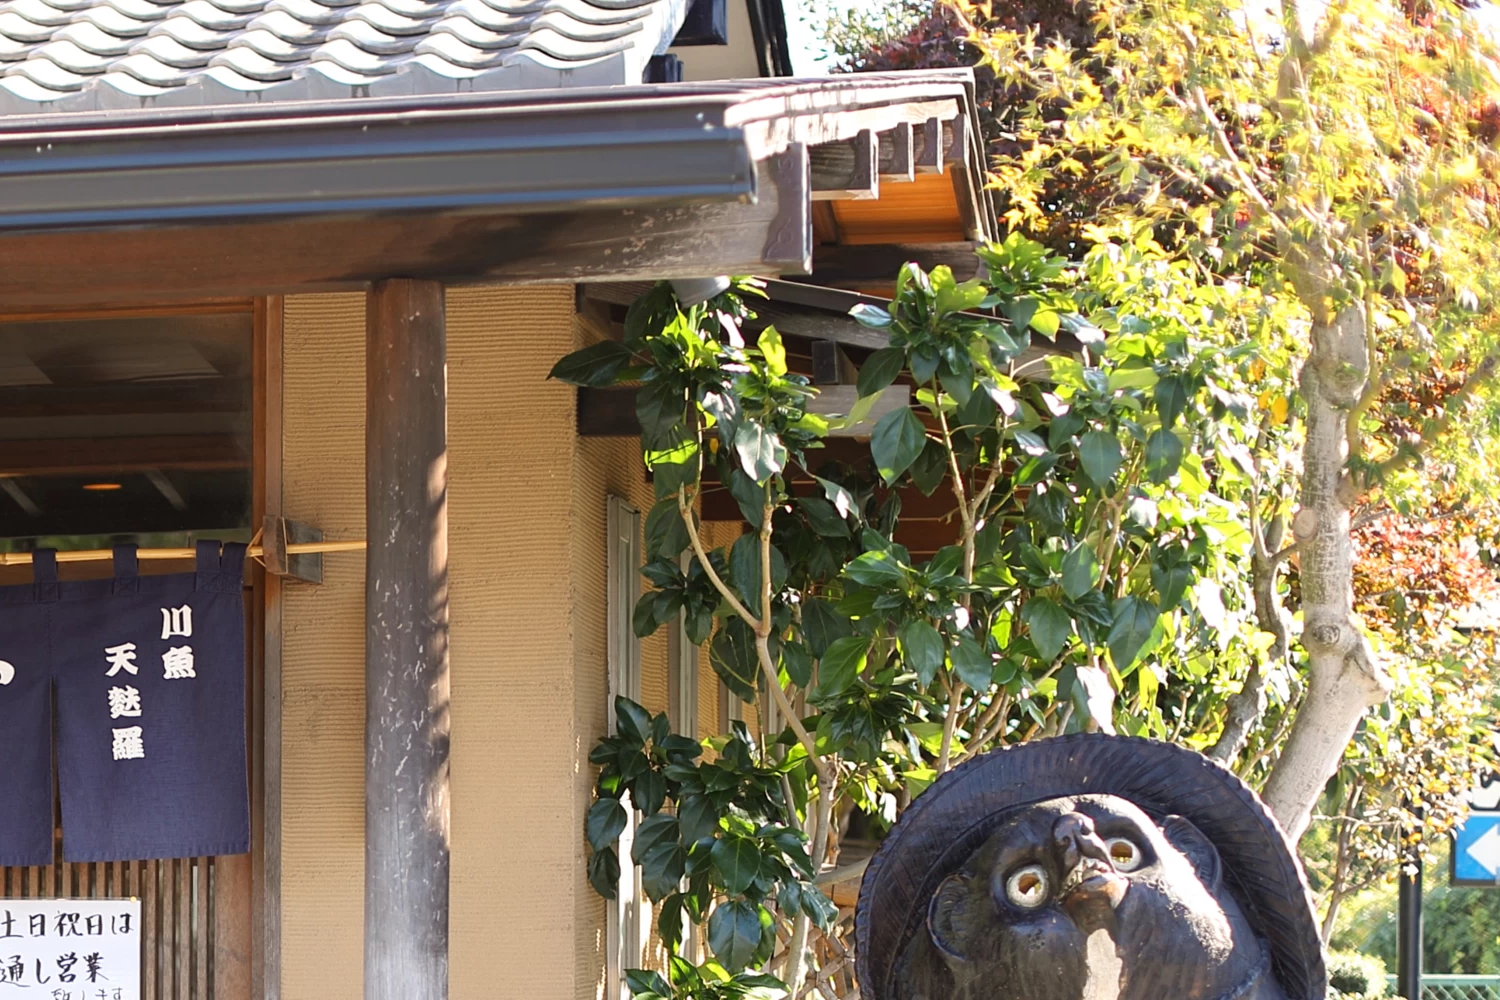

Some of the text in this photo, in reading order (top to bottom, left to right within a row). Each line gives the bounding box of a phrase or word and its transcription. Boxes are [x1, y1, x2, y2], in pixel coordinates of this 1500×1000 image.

[160, 604, 197, 680] 川魚
[104, 642, 146, 761] 天麩羅
